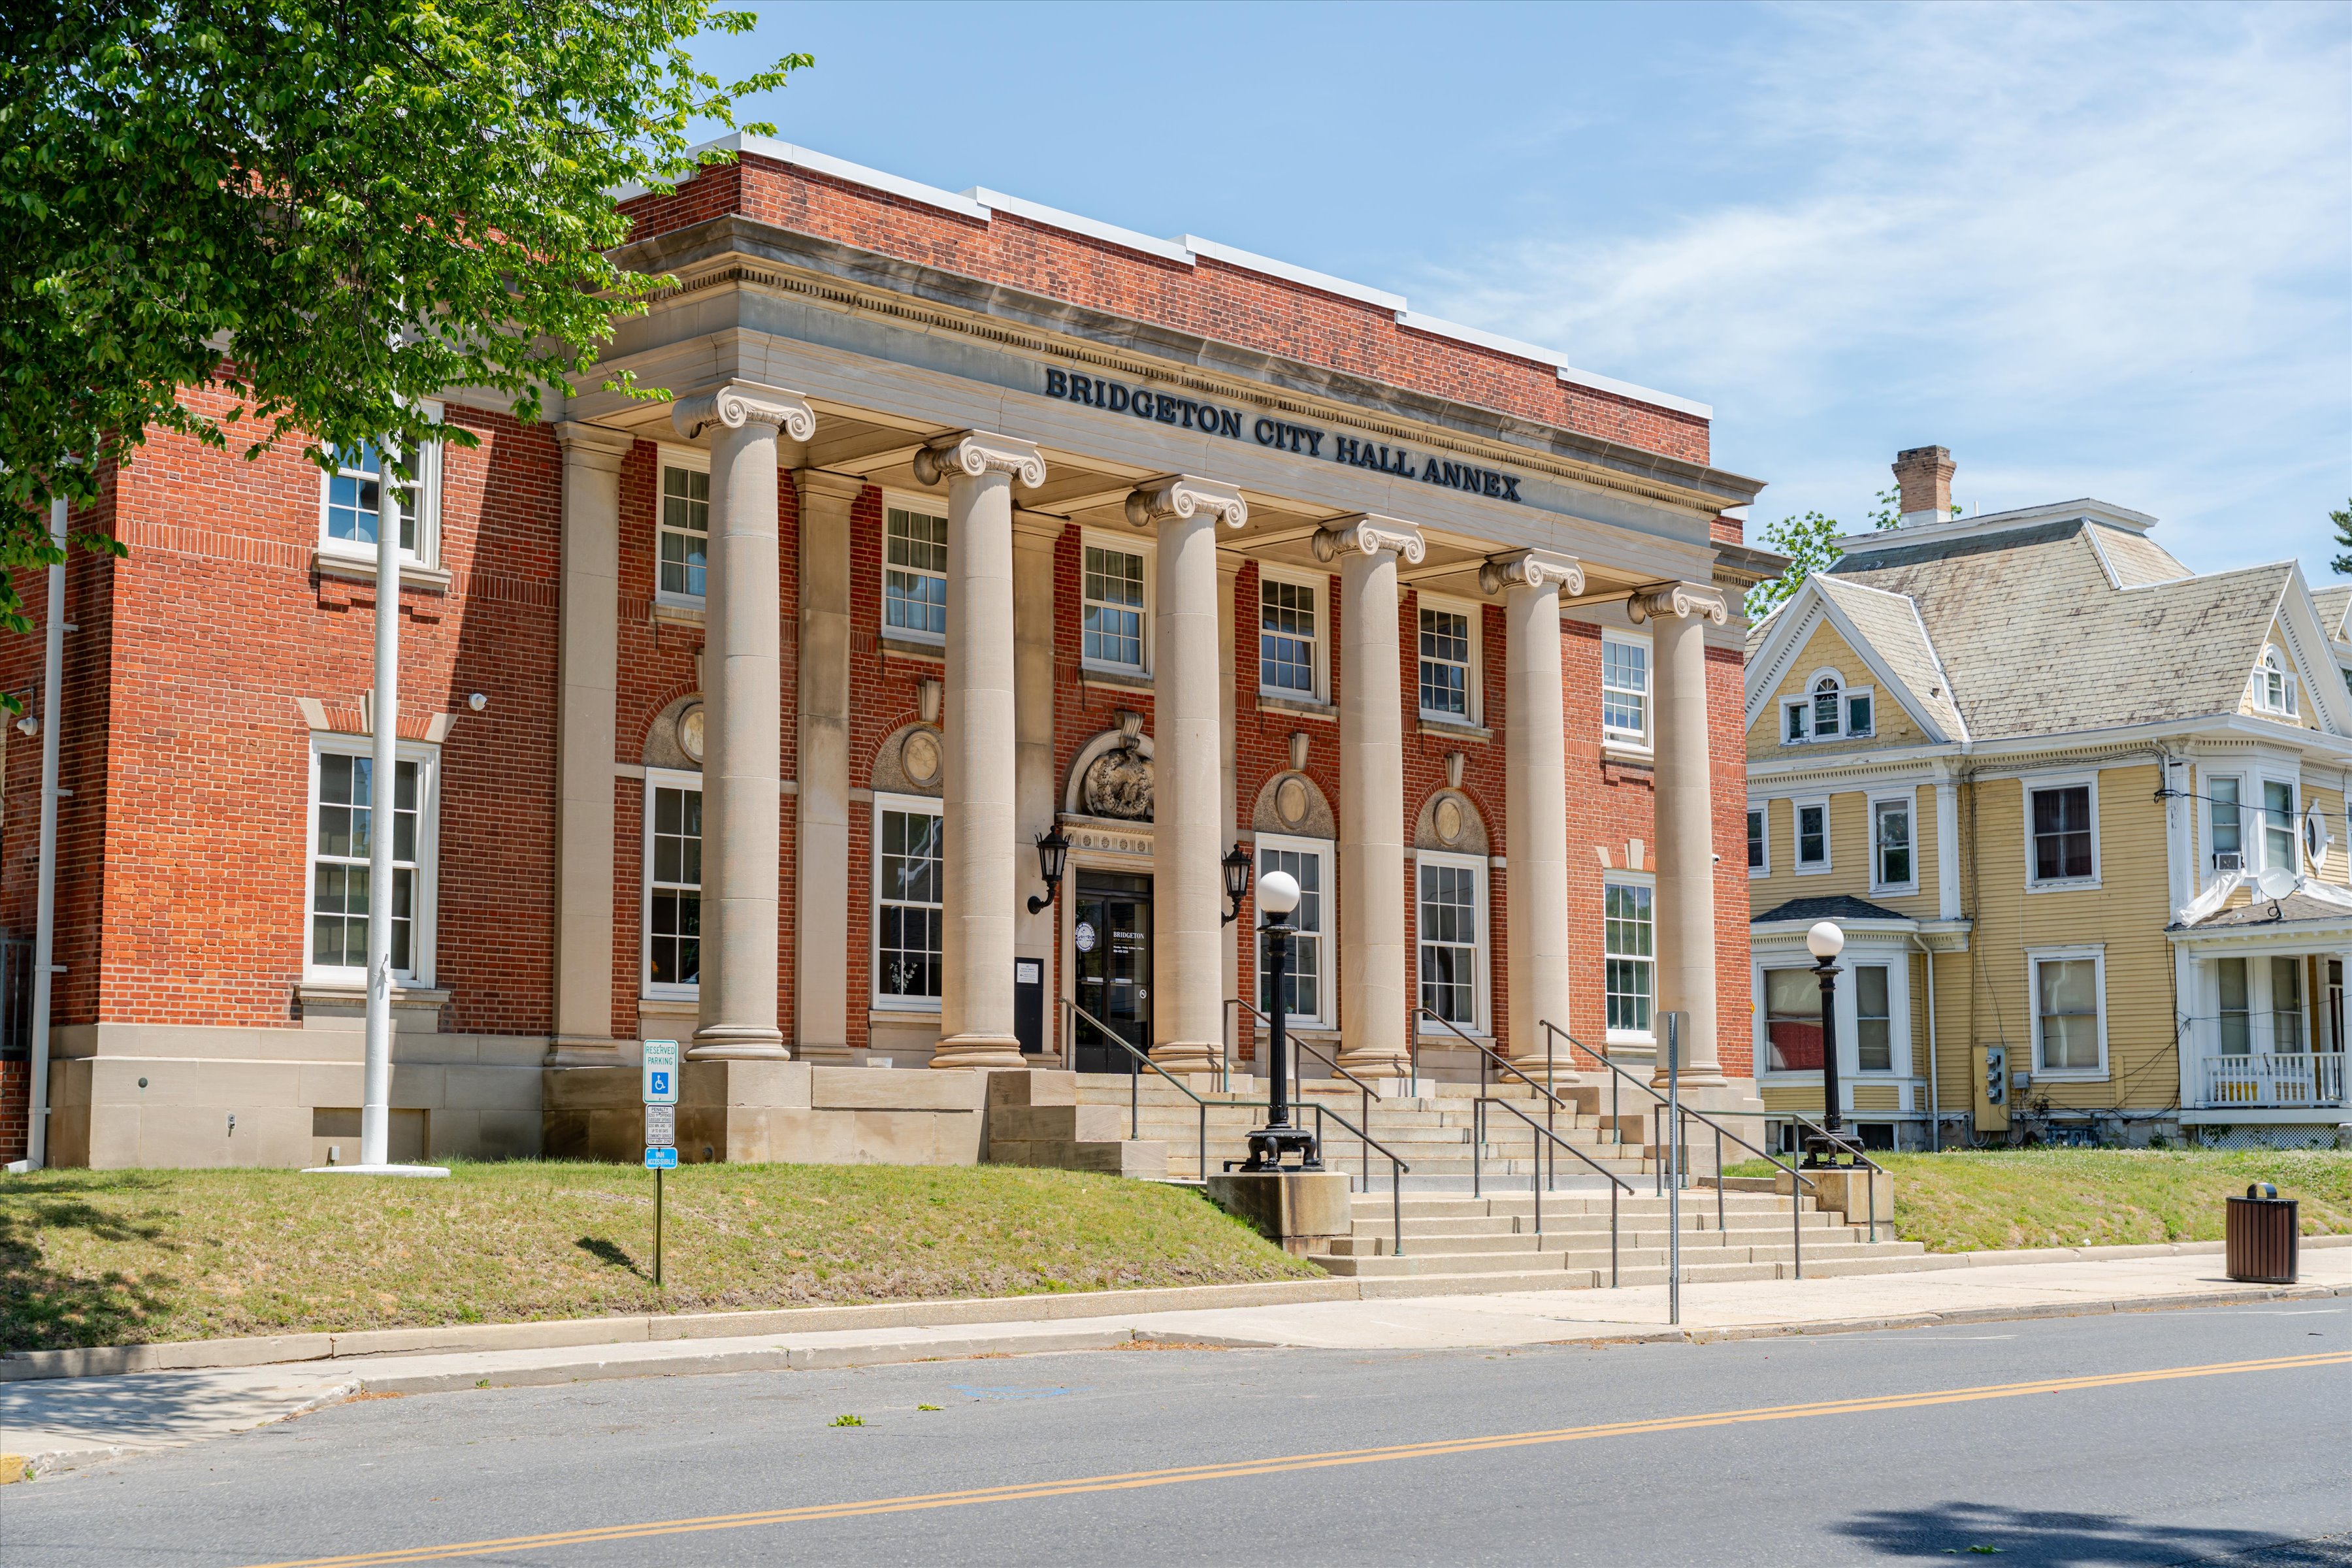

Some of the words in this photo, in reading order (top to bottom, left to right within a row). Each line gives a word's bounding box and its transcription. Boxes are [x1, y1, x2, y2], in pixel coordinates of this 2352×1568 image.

[1047, 368, 1242, 438] BRIDGETON
[1254, 418, 1325, 456] CITY
[1337, 436, 1416, 478] HALL
[1423, 458, 1522, 502] ANNEX
[1113, 931, 1145, 939] BRIDGETON
[645, 1046, 675, 1055] RESERVED
[647, 1056, 673, 1066] PARKING
